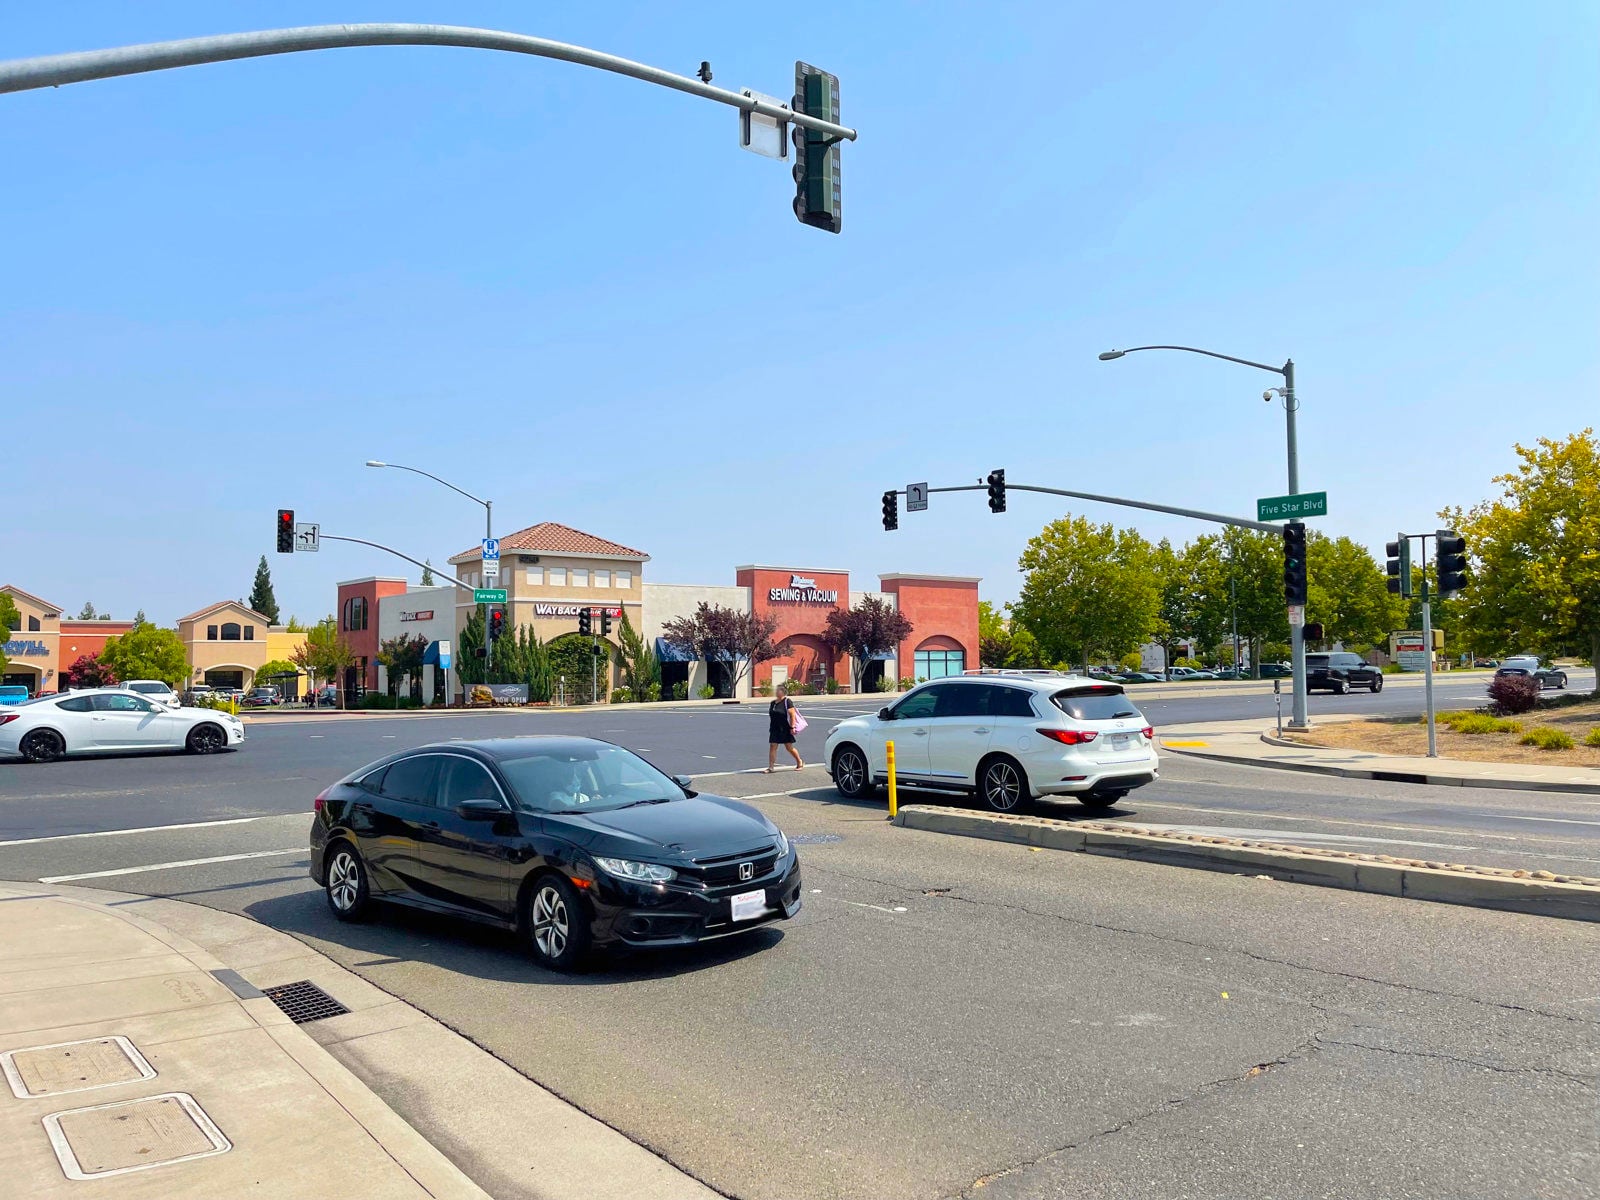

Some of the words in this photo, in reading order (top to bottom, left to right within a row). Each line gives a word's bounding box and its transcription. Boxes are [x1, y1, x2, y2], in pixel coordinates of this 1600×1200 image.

[1261, 505, 1279, 515] Five
[1282, 503, 1300, 513] Star
[1303, 499, 1323, 511] Blvd
[476, 592, 497, 601] Fairway
[770, 588, 800, 601] SEWING
[801, 592, 806, 601] &
[807, 589, 838, 602] VACUUM
[535, 603, 582, 615] WAYBACK
